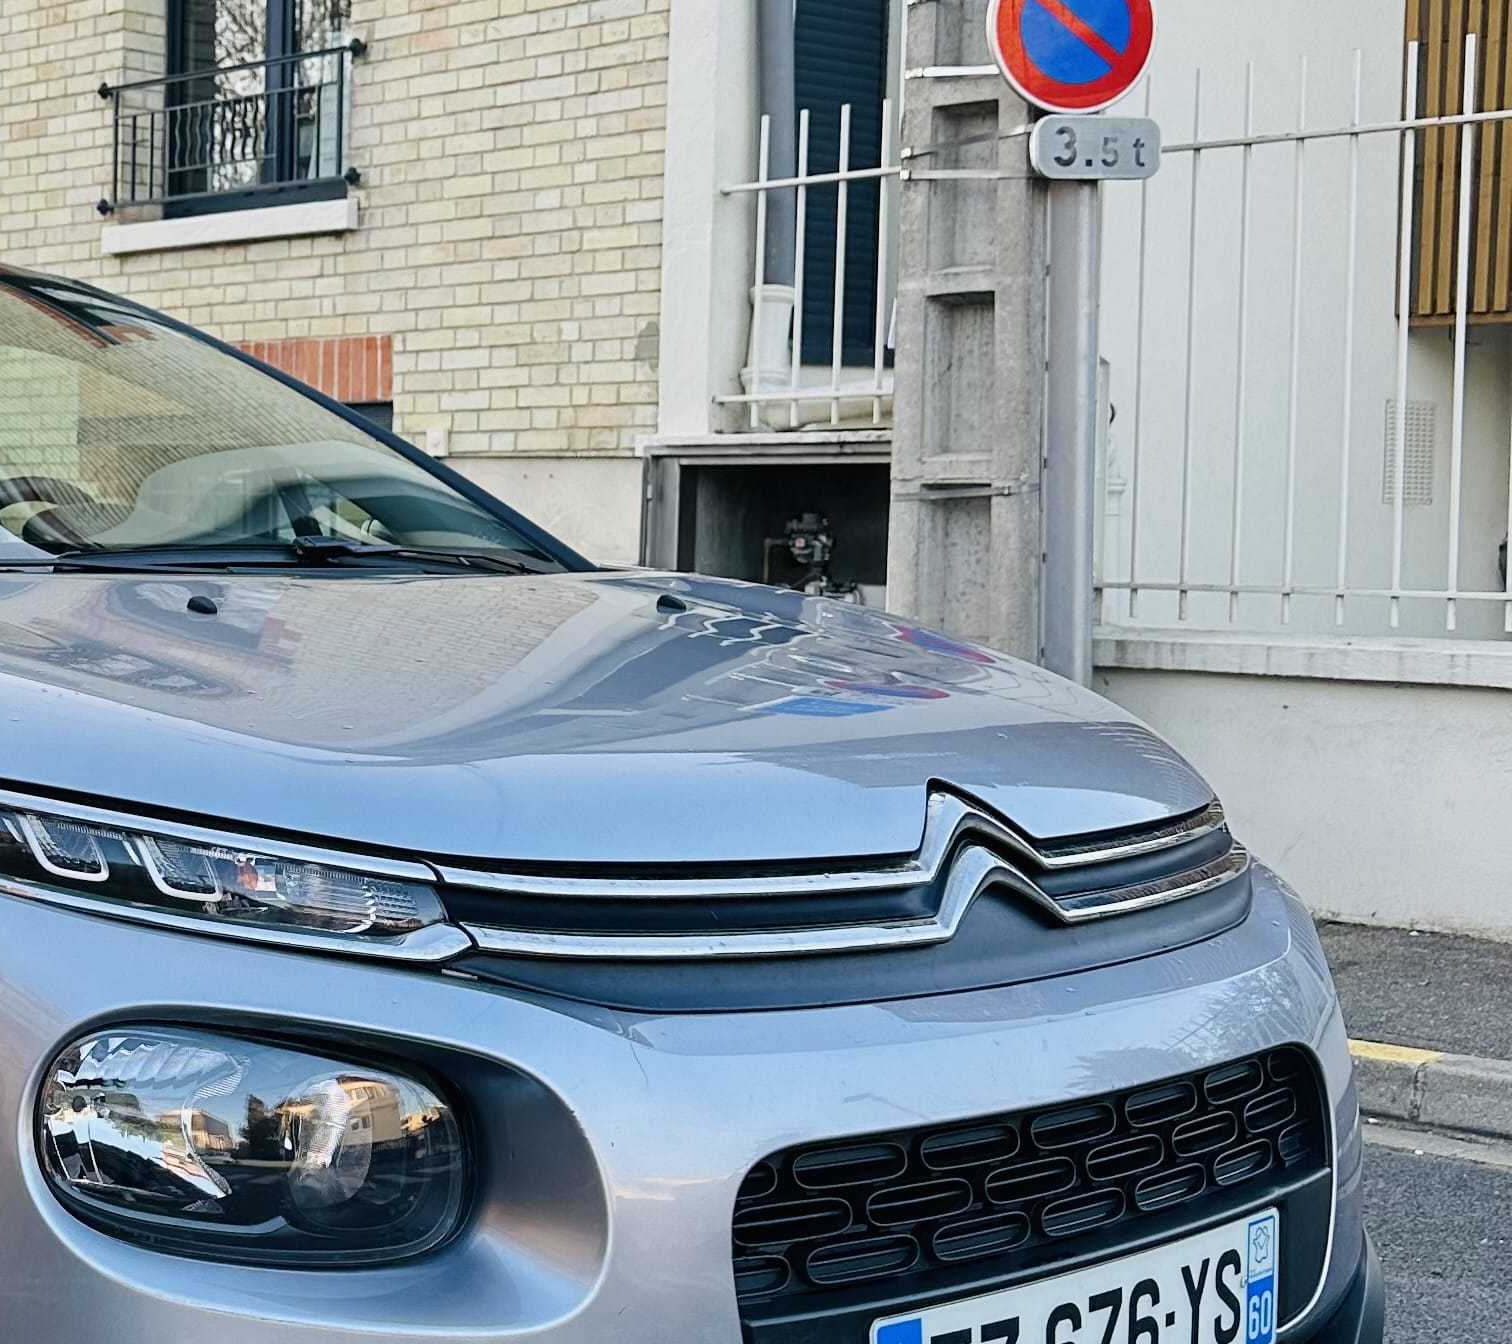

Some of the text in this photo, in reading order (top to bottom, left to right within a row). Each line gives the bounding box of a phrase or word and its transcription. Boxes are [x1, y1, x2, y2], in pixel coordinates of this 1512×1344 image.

[1053, 126, 1145, 167] 3.5 t
[1249, 1290, 1272, 1340] 60
